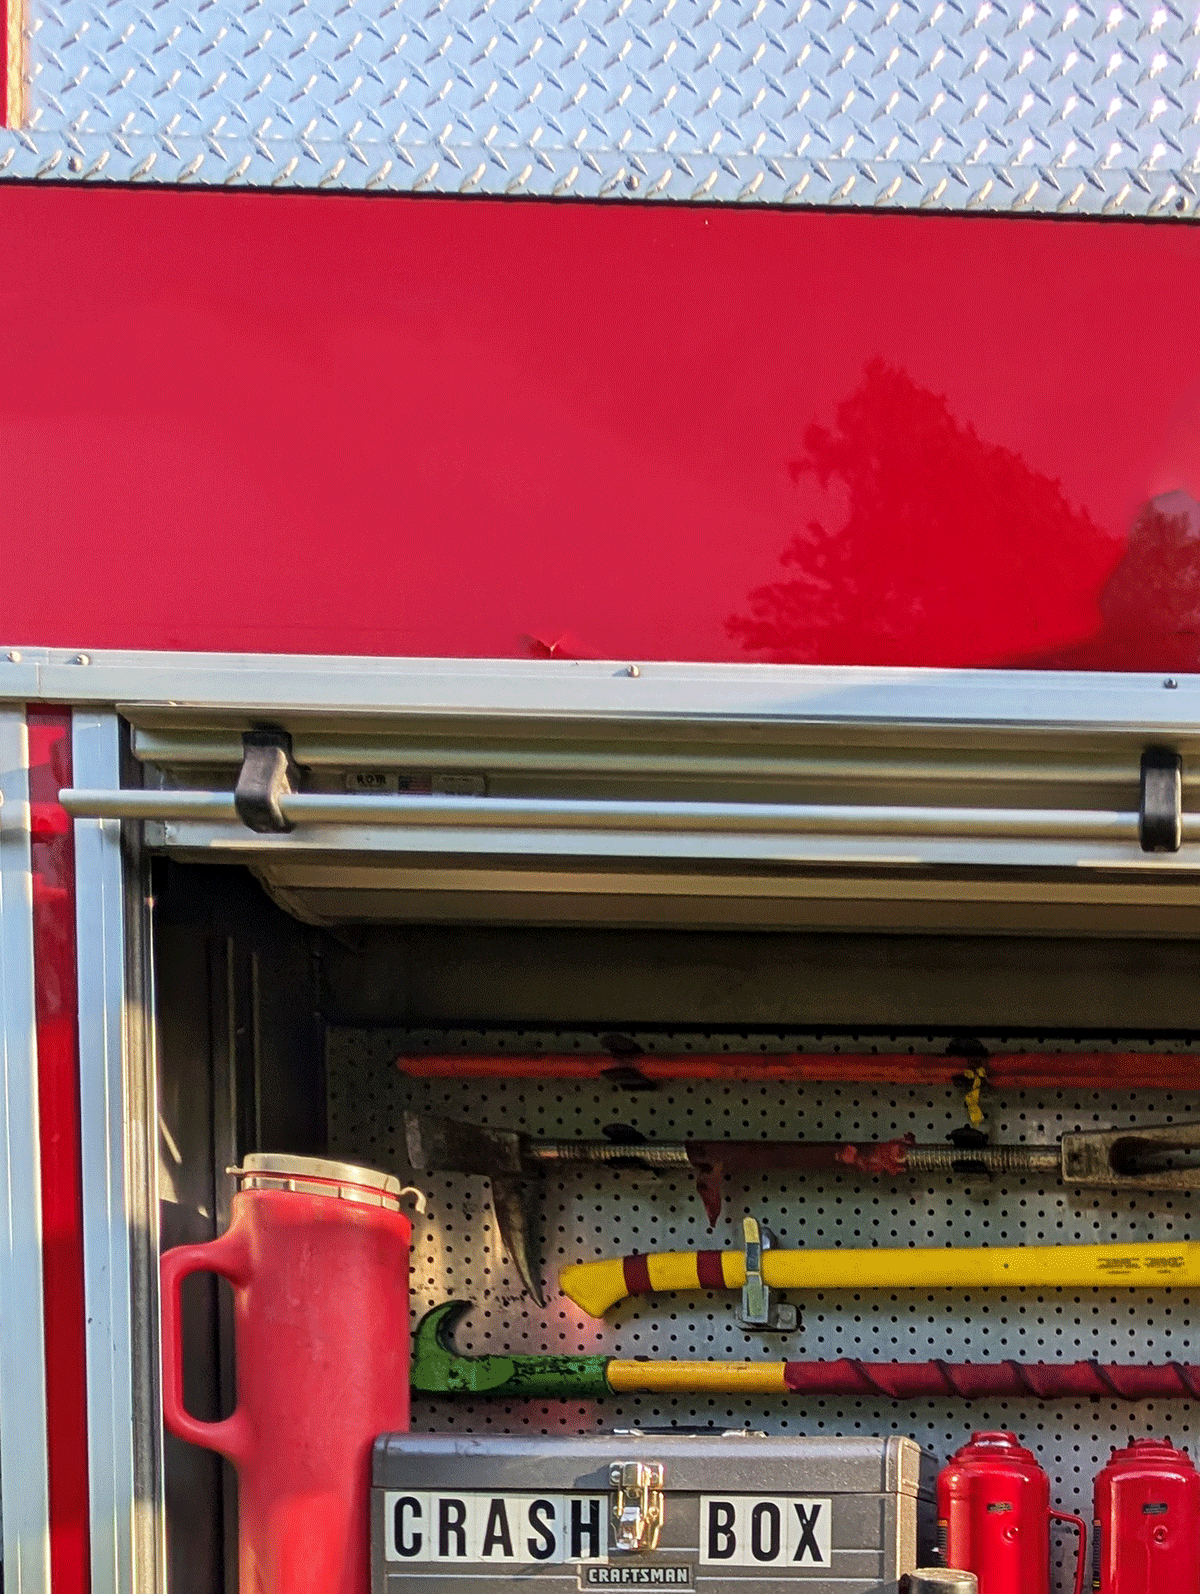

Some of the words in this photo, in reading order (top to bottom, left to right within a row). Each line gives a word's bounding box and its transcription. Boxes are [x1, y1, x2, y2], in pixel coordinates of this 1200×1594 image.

[393, 1496, 601, 1559] CRASH
[708, 1501, 825, 1562] BOX
[588, 1566, 689, 1584] CRAFTSMAN
